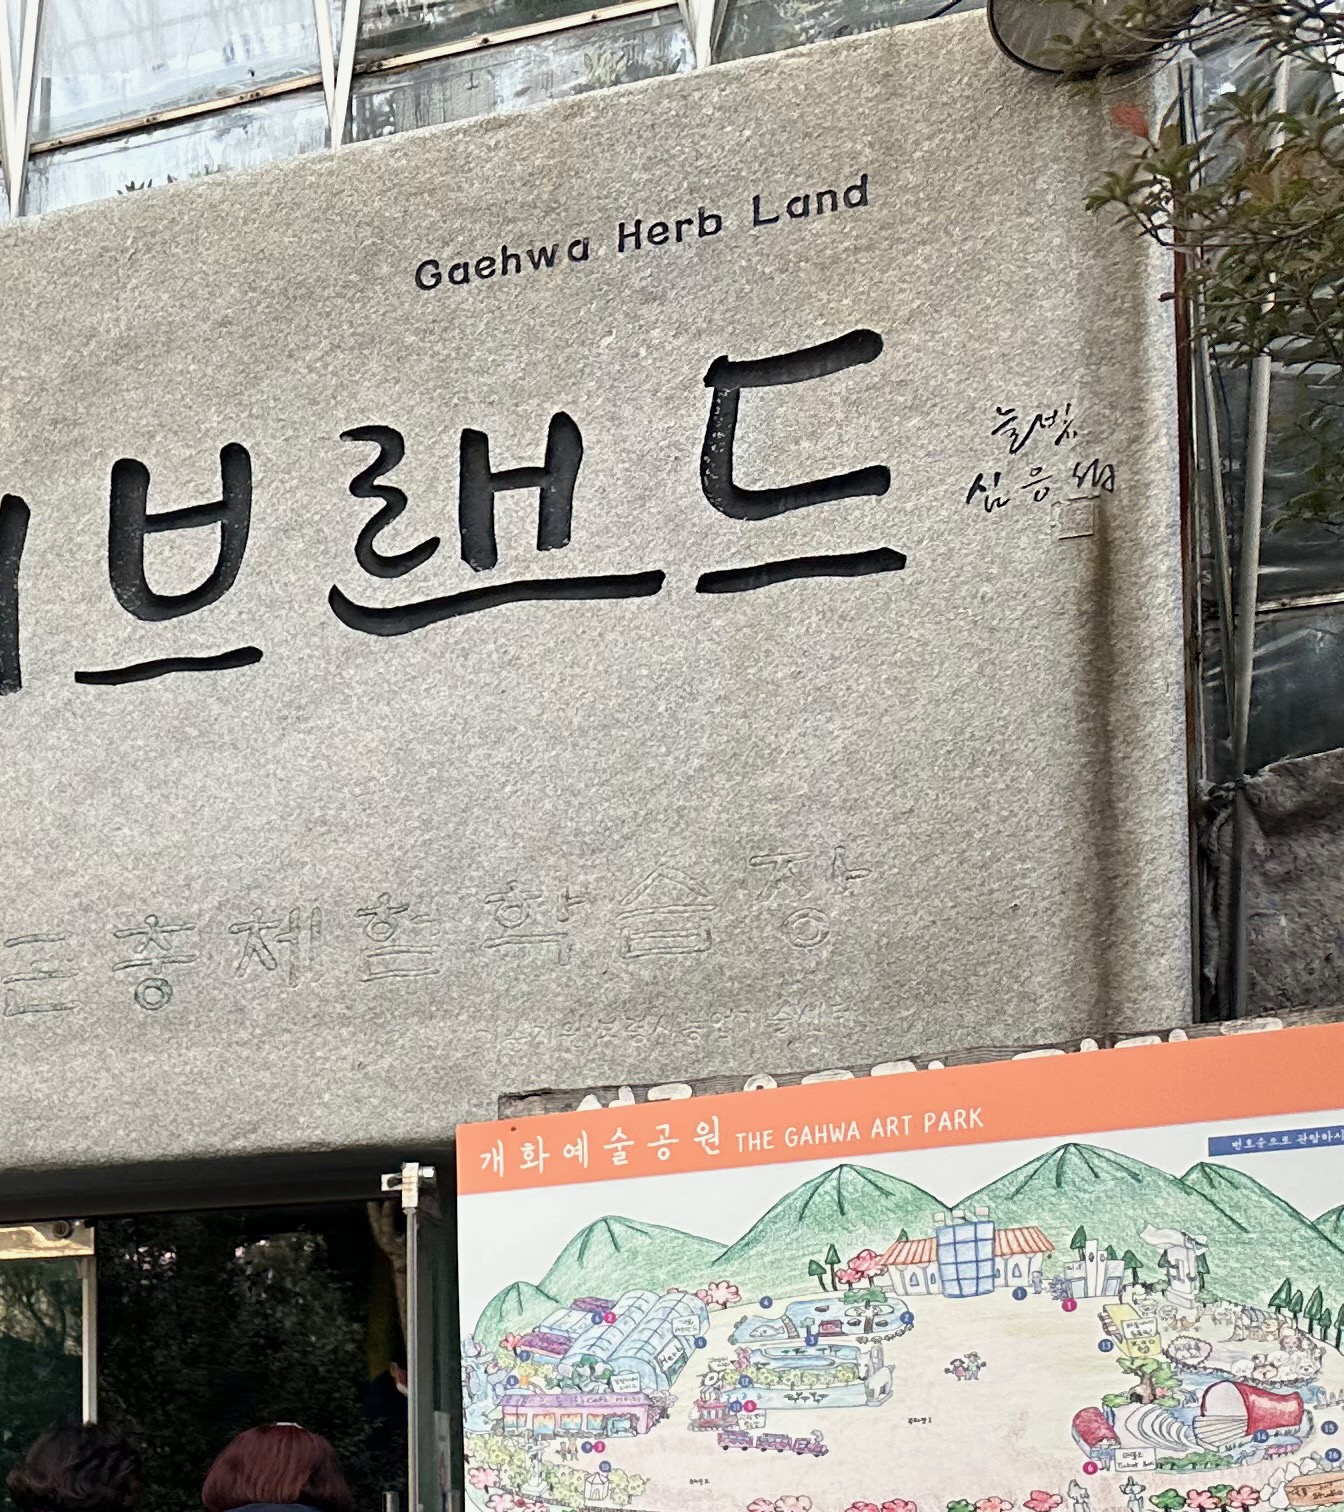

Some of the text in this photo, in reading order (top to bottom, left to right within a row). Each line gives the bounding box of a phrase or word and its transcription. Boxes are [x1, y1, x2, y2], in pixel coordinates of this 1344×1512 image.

[414, 174, 870, 292] Gaehwa Herb Land
[479, 1107, 984, 1178] 개화예술공원 THE GAHWA ART PARK
